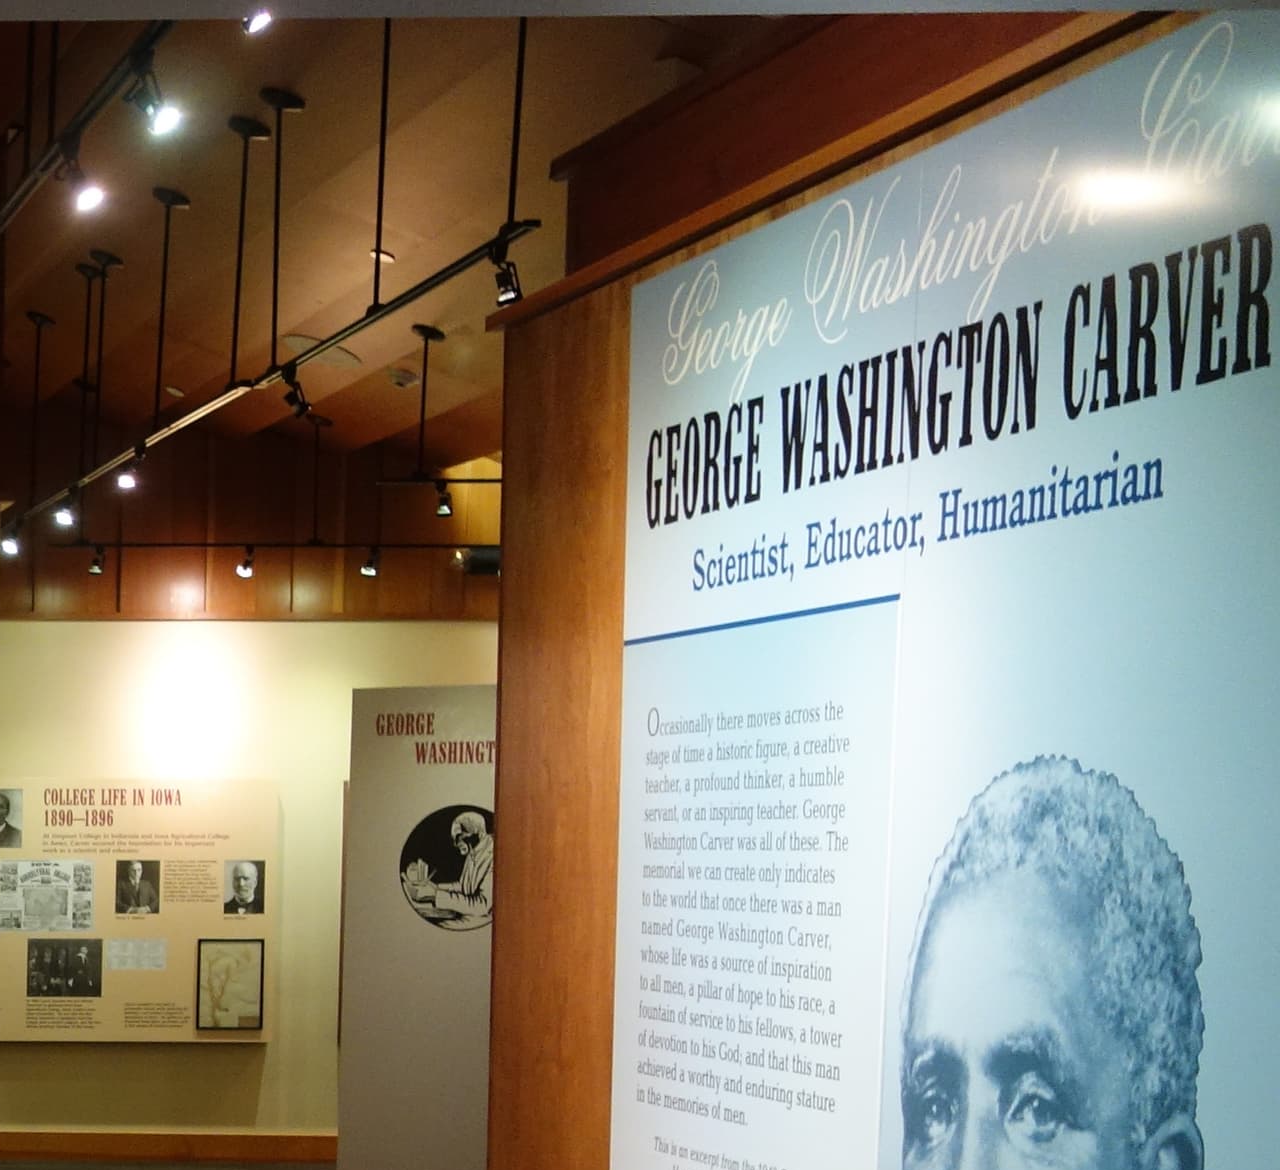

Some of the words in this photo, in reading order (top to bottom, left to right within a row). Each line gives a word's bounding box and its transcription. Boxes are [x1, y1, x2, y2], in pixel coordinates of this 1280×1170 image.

[663, 260, 792, 402] George
[646, 396, 764, 529] GEORGE
[780, 301, 1043, 494] WASHINGTON
[1063, 223, 1272, 420] CARVER
[693, 532, 795, 592] Scientist,
[805, 507, 926, 569] Educator,
[937, 450, 1164, 543] Humanitarian
[376, 712, 435, 736] GEORGE
[647, 709, 713, 736] Occasionally
[717, 711, 743, 731] there
[747, 711, 781, 728] moves
[785, 707, 820, 725] across
[824, 700, 843, 720] the
[646, 749, 670, 770] stage
[671, 745, 681, 763] of
[683, 745, 705, 763] time
[707, 747, 713, 761] a
[716, 741, 753, 760] historic
[756, 738, 790, 764] figure,
[793, 740, 800, 756] a
[803, 734, 849, 755] creative
[44, 788, 96, 806] COLLEGE
[101, 788, 127, 806] LIFE
[132, 788, 145, 806] IN
[151, 788, 182, 806] IOWA
[645, 775, 680, 794] teacher,
[685, 778, 690, 792] a
[693, 770, 740, 797] profound
[743, 769, 784, 789] thinker,
[789, 773, 796, 788] a
[799, 765, 844, 787] humble
[644, 805, 679, 822] servant,
[682, 807, 692, 821] or
[694, 807, 706, 821] an
[710, 806, 752, 826] inspiring
[757, 799, 798, 820] teacher.
[802, 799, 846, 824] George
[644, 831, 697, 855] Washington
[700, 831, 734, 850] Carver
[737, 836, 757, 850] was
[759, 831, 773, 851] all
[775, 831, 788, 851] of
[789, 831, 821, 851] these.
[826, 830, 848, 851] The
[643, 860, 684, 879] memorial
[687, 866, 702, 880] we
[704, 866, 721, 880] can
[724, 864, 755, 881] create
[758, 862, 781, 888] only
[785, 862, 835, 884] indicates
[642, 890, 651, 906] to
[652, 889, 667, 907] the
[670, 890, 697, 909] world
[700, 891, 718, 910] that
[722, 896, 746, 912] once
[750, 892, 777, 913] there
[781, 899, 804, 914] was
[806, 900, 813, 915] a
[816, 901, 841, 917] man
[641, 918, 673, 936] named
[676, 918, 714, 944] George
[717, 921, 783, 949] Washington
[788, 926, 831, 950] Carver,
[640, 945, 669, 964] whose
[671, 946, 687, 966] life
[690, 953, 709, 968] was
[712, 956, 717, 970] a
[720, 956, 754, 973] source
[757, 955, 767, 975] of
[771, 956, 831, 983] inspiration
[640, 975, 648, 991] to
[650, 974, 661, 992] all
[663, 979, 686, 997] men,
[689, 983, 694, 996] a
[697, 979, 723, 1003] pillar
[725, 983, 735, 1002] of
[737, 983, 763, 1010] hope
[766, 988, 776, 1006] to
[779, 988, 794, 1009] his
[798, 996, 825, 1015] race,
[829, 999, 835, 1015] a
[639, 999, 675, 1023] fountain
[678, 1006, 687, 1024] of
[689, 1010, 723, 1030] service
[727, 1014, 735, 1032] to
[738, 1014, 753, 1034] his
[755, 1016, 796, 1042] fellows,
[799, 1028, 808, 1043] a
[810, 1026, 842, 1048] tower
[638, 1029, 647, 1047] of
[649, 1029, 687, 1054] devotion
[690, 1039, 699, 1056] to
[702, 1038, 716, 1058] his
[719, 1041, 742, 1065] God;
[745, 1048, 765, 1068] and
[768, 1049, 790, 1072] that
[792, 1053, 813, 1076] this
[816, 1063, 840, 1081] man
[637, 1057, 677, 1080] achieved
[679, 1069, 685, 1082] a
[688, 1069, 721, 1094] worthy
[724, 1075, 742, 1094] and
[745, 1079, 793, 1110] enduring
[796, 1089, 835, 1112] stature
[636, 1088, 645, 1102] in
[647, 1087, 661, 1106] the
[664, 1094, 709, 1117] memories
[711, 1101, 720, 1120] of
[723, 1107, 746, 1125] men.
